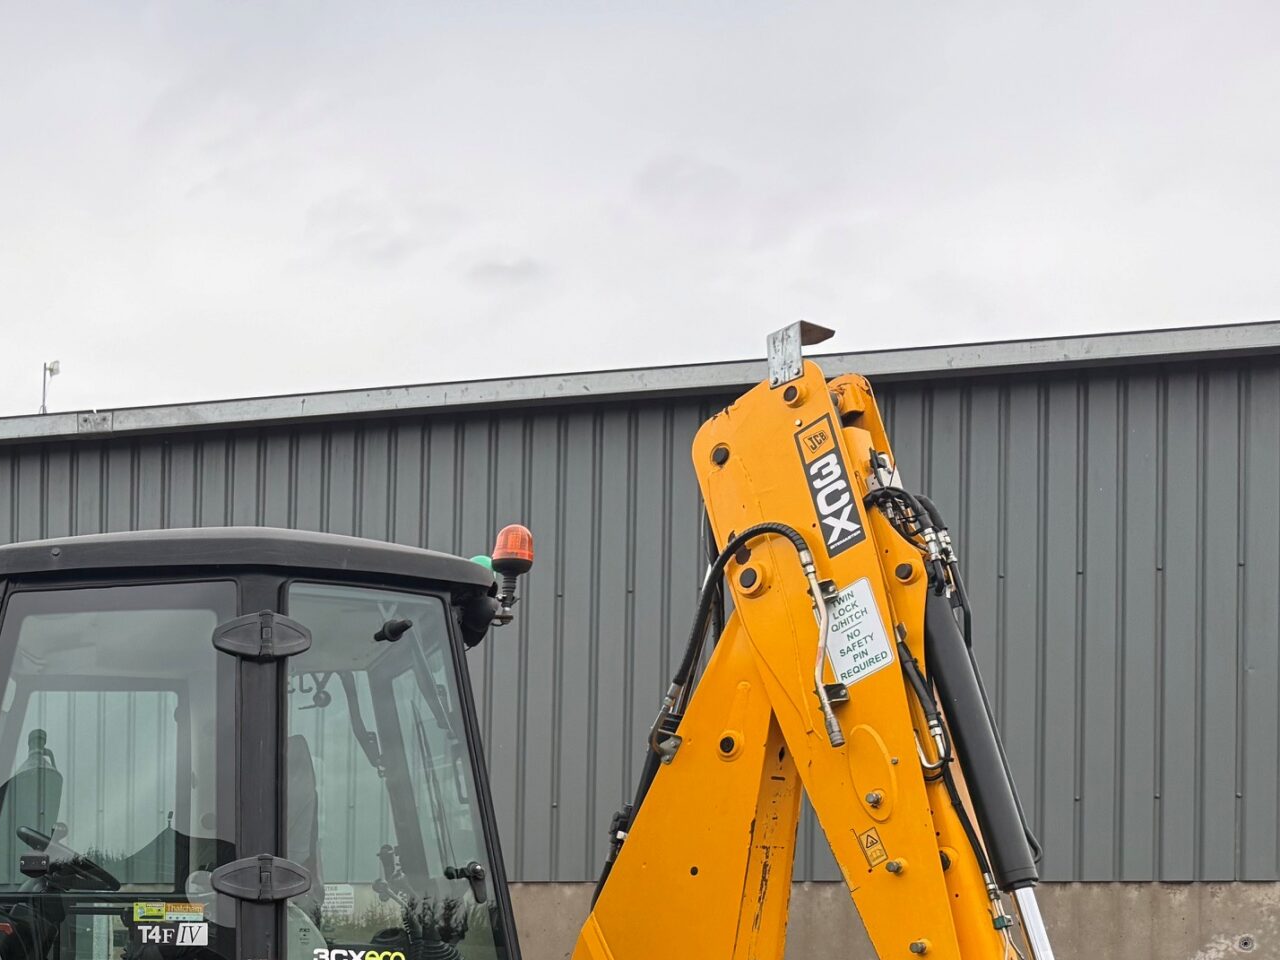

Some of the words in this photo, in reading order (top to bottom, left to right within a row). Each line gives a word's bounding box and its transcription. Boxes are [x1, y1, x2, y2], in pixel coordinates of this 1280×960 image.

[806, 431, 828, 452] JCB
[809, 453, 861, 546] 3CX
[831, 590, 855, 608] TWIN
[831, 607, 868, 632] Q/HITCH
[832, 600, 859, 620] LOCK
[839, 632, 874, 657] SAFETY
[847, 628, 861, 641] NO
[840, 650, 888, 680] REQUIRED
[852, 648, 869, 662] PIN
[138, 925, 175, 943] T4F
[179, 926, 203, 944] IV
